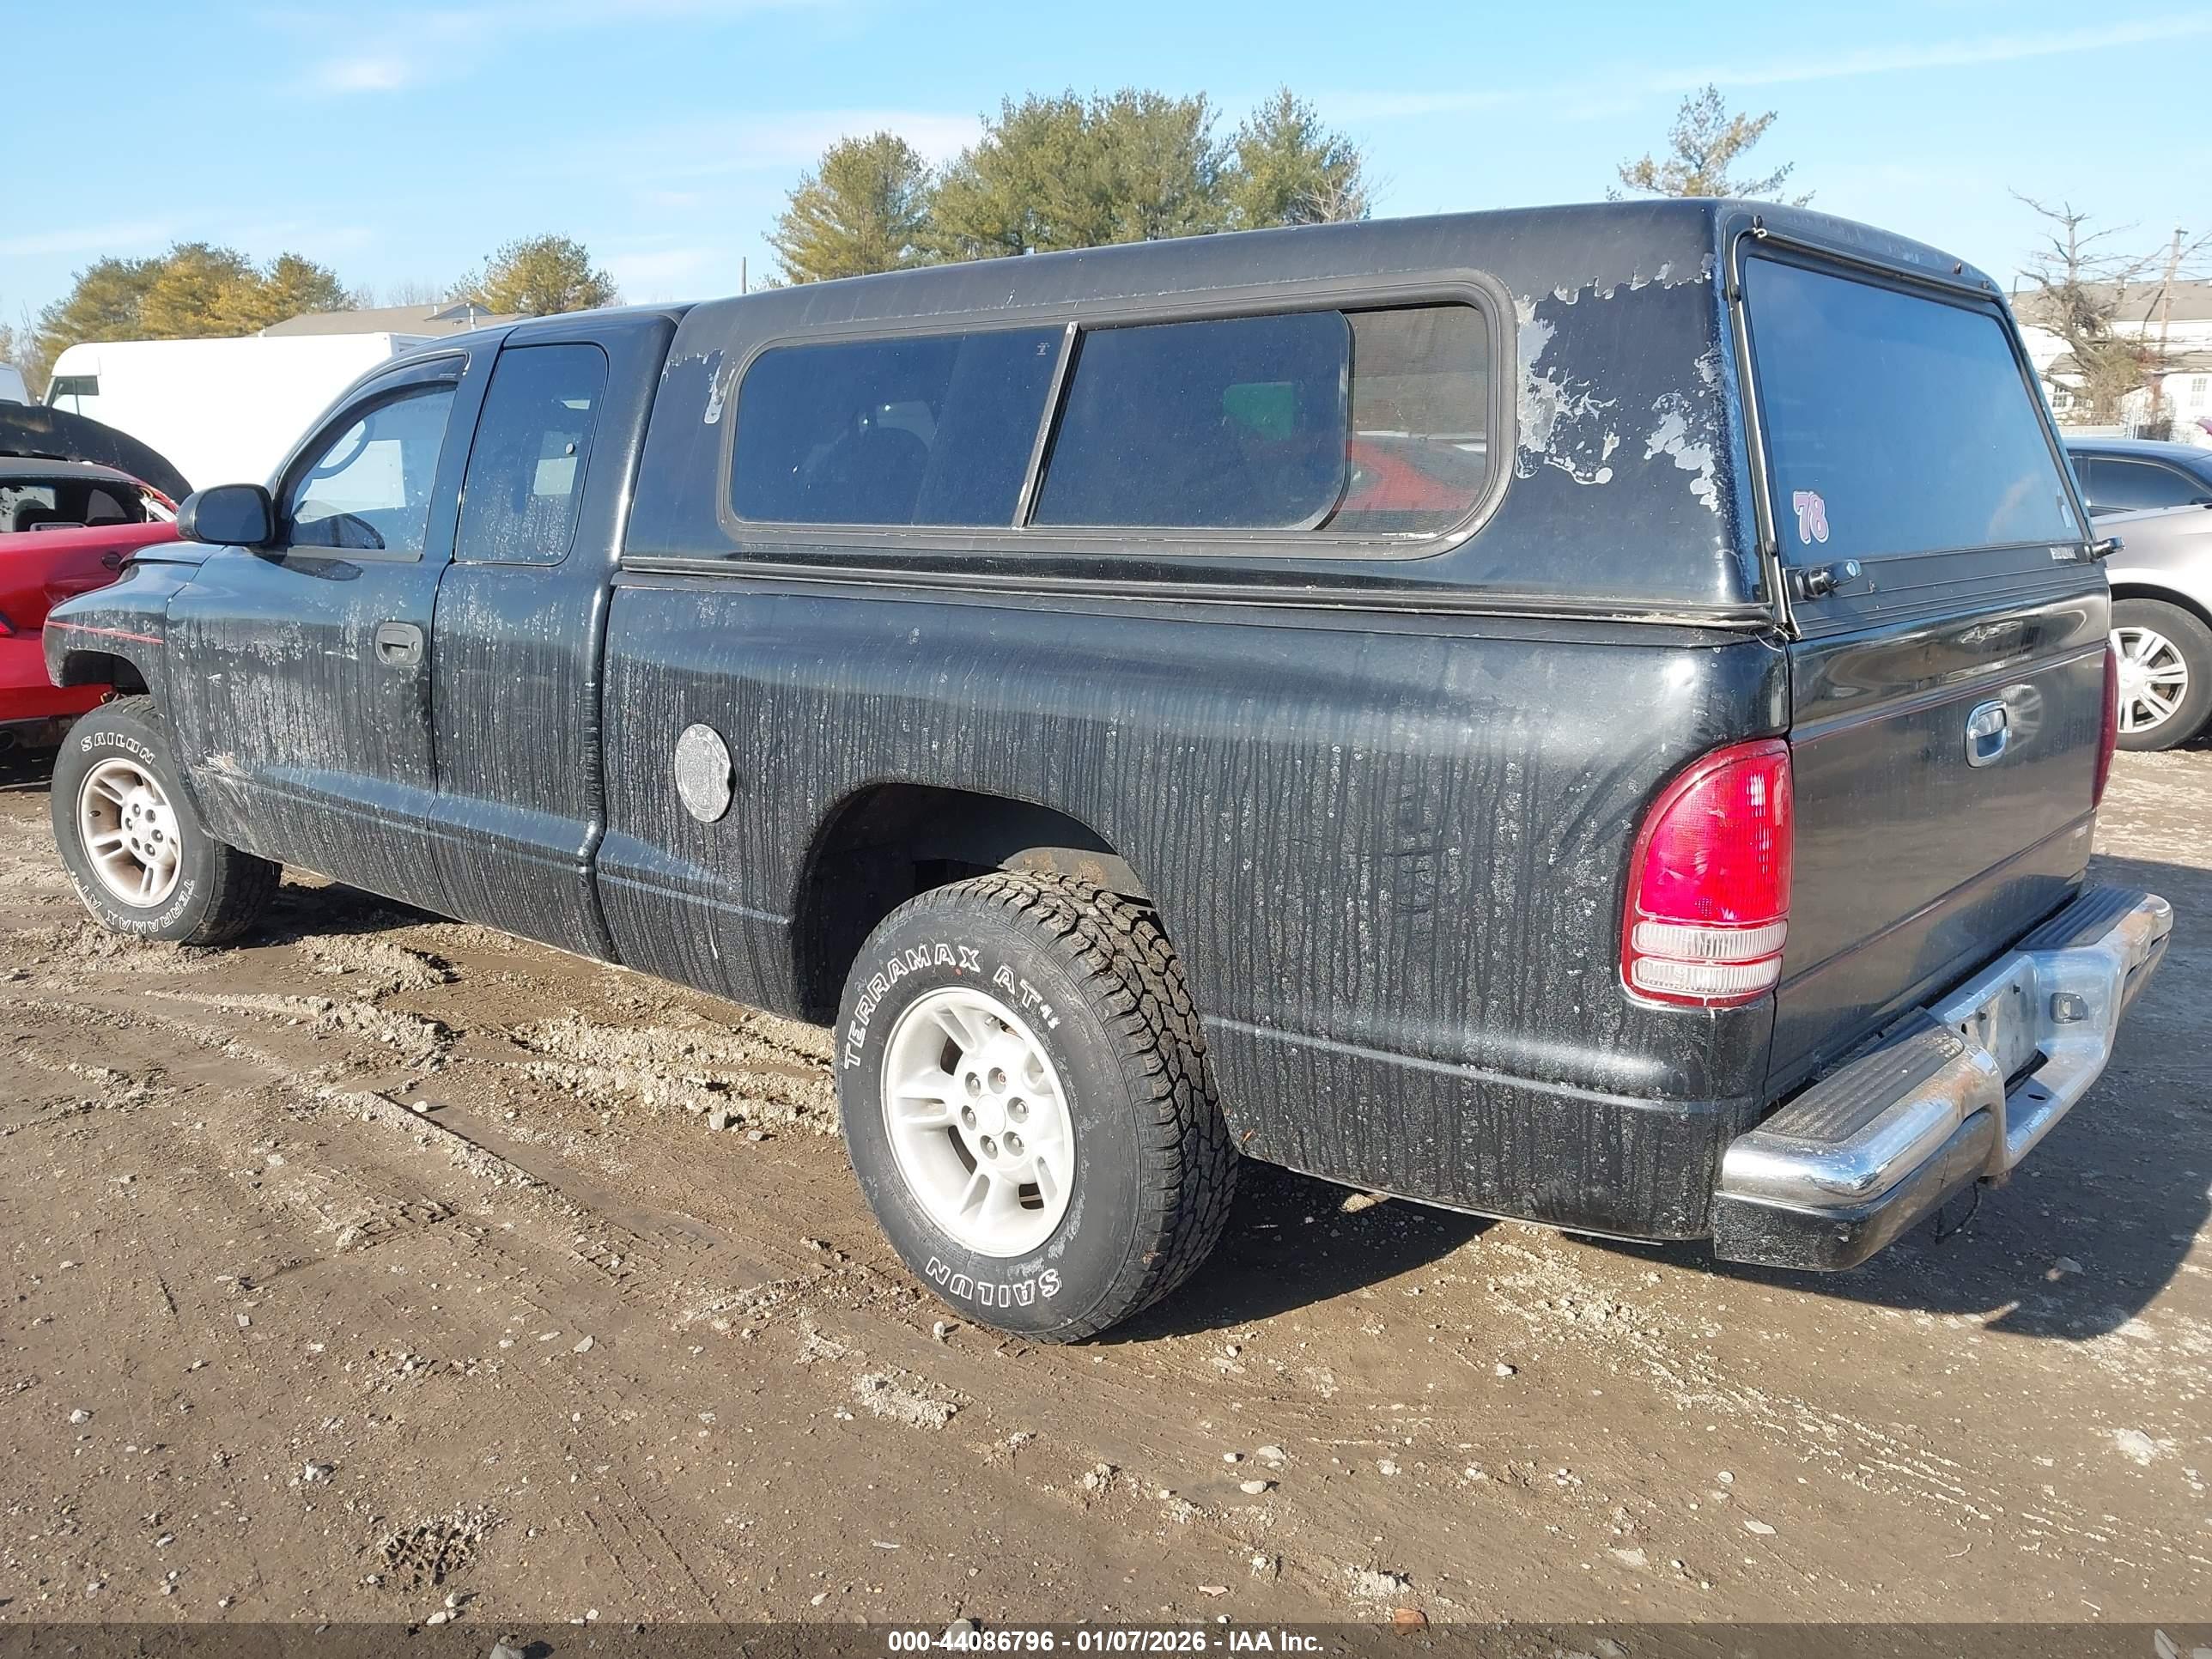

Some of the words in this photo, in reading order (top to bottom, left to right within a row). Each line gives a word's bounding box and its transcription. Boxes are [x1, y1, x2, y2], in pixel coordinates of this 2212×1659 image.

[1792, 490, 1830, 545] 78
[81, 732, 155, 764] SAILUN
[105, 878, 197, 935] TERRAMAX
[844, 943, 982, 1070] TERRAMAX
[925, 1255, 1065, 1309] SAILUN
